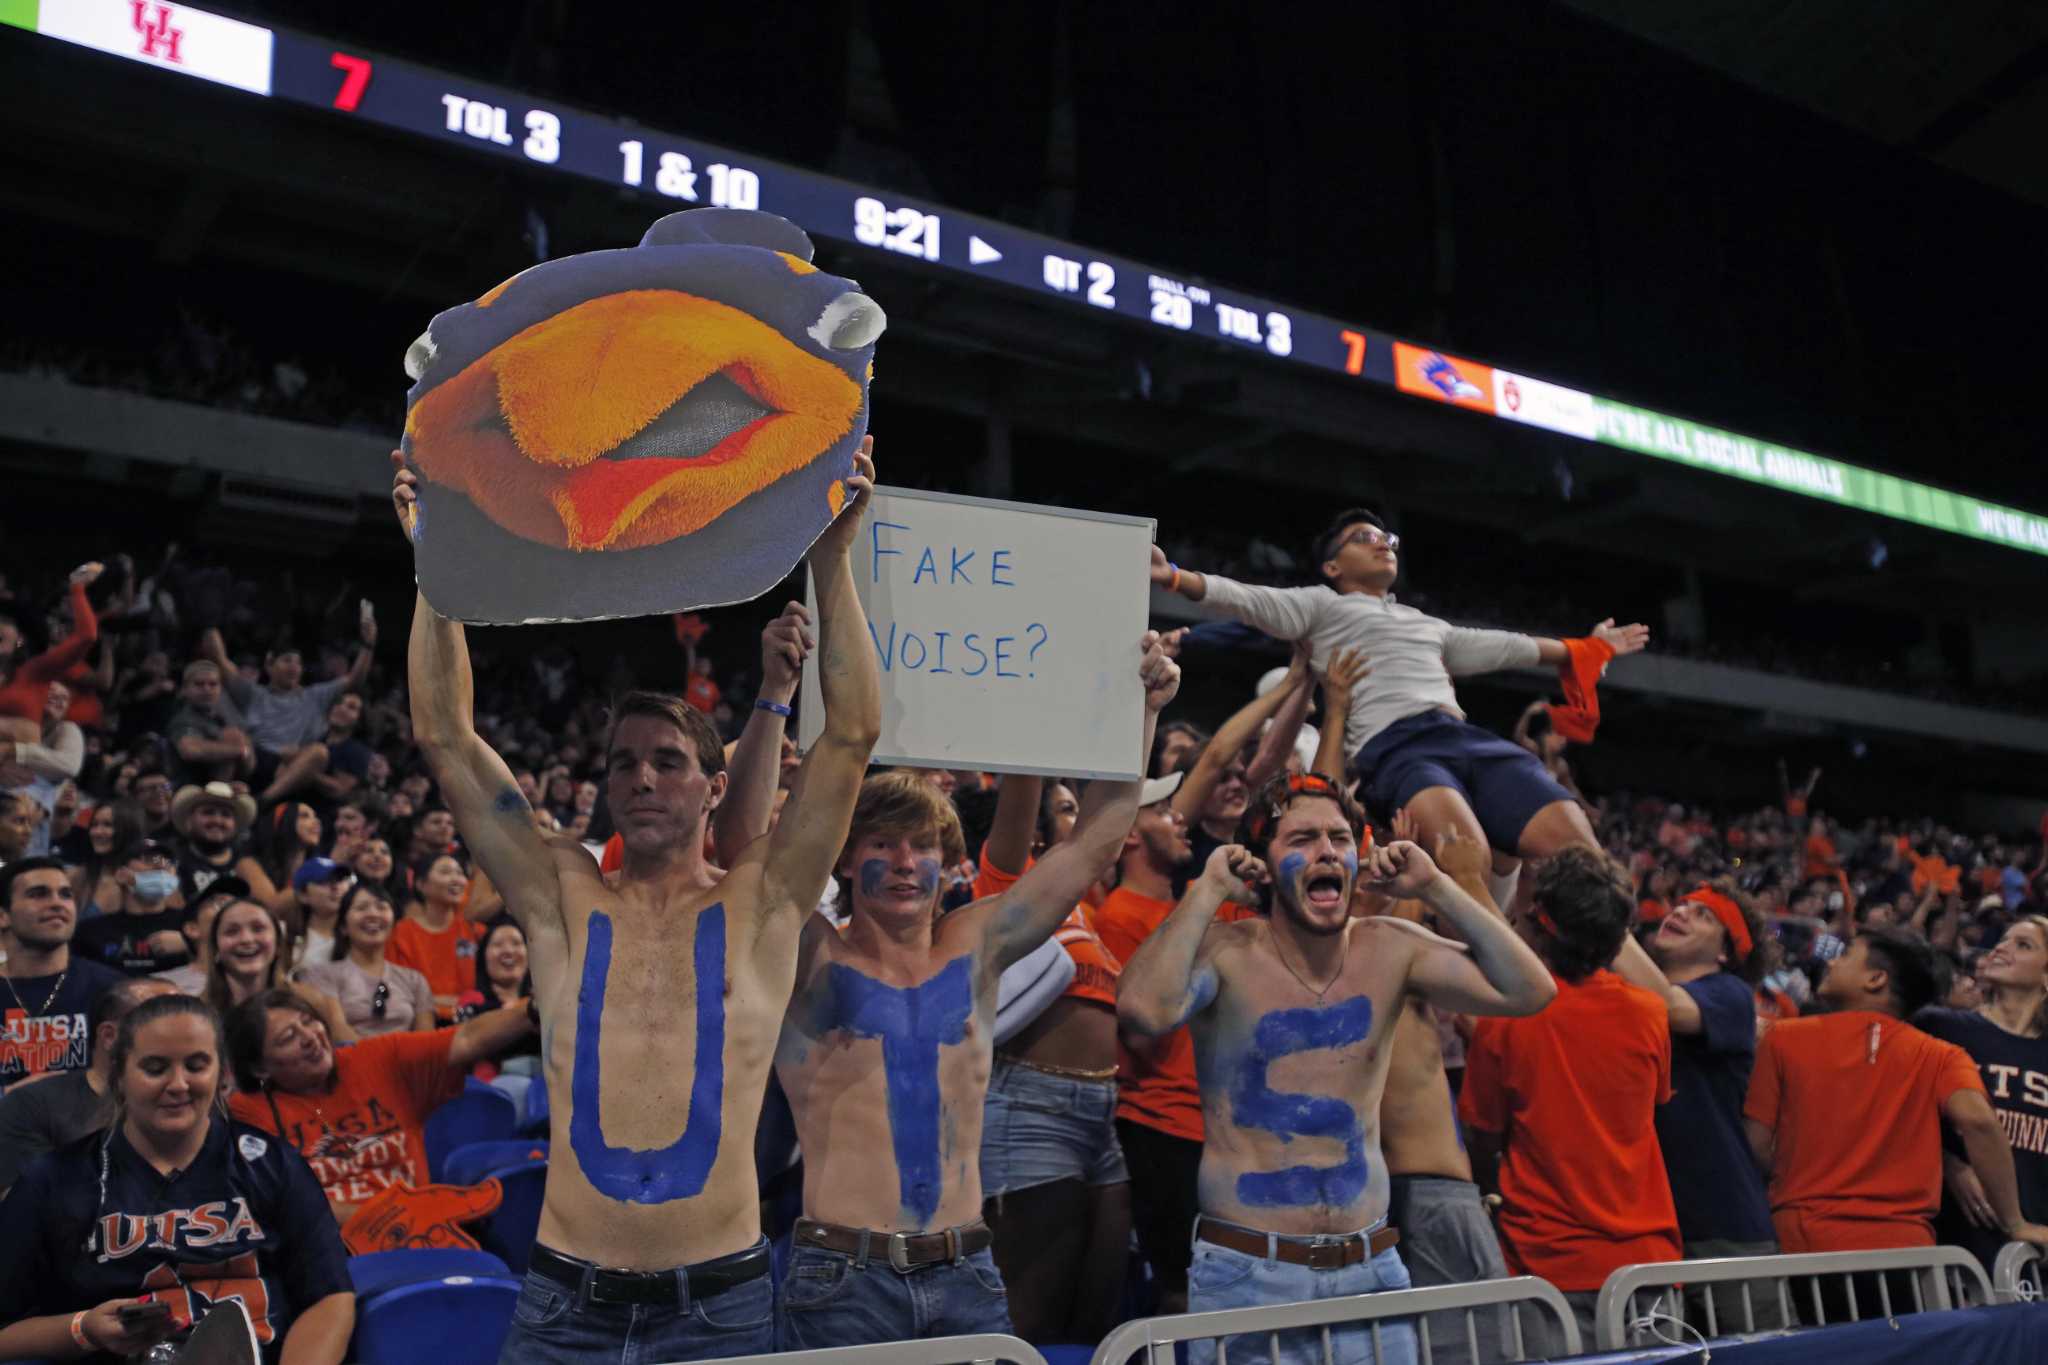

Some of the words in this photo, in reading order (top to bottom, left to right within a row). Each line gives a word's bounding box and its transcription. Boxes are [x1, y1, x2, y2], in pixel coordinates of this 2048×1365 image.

[331, 52, 372, 112] 7
[441, 93, 513, 146] TOL
[523, 109, 561, 164] 3
[619, 140, 643, 187] 1
[656, 151, 698, 202] &
[706, 163, 760, 210] 10
[854, 197, 940, 262] 9:21
[1043, 254, 1083, 293] QT
[1087, 261, 1116, 309] 2
[1150, 290, 1193, 331] 20
[1215, 303, 1263, 344] TOL
[1266, 311, 1292, 356] 3
[1341, 329, 1366, 376] 7
[872, 521, 1016, 586] FAKE
[0, 1040, 86, 1073] ATION
[7, 1013, 88, 1044] UTSA
[570, 902, 727, 1205] U
[803, 954, 975, 1231] T
[1232, 995, 1373, 1206] S
[1976, 1064, 2048, 1108] TS
[309, 1132, 406, 1187] OWDY
[97, 1196, 265, 1264] UTSA
